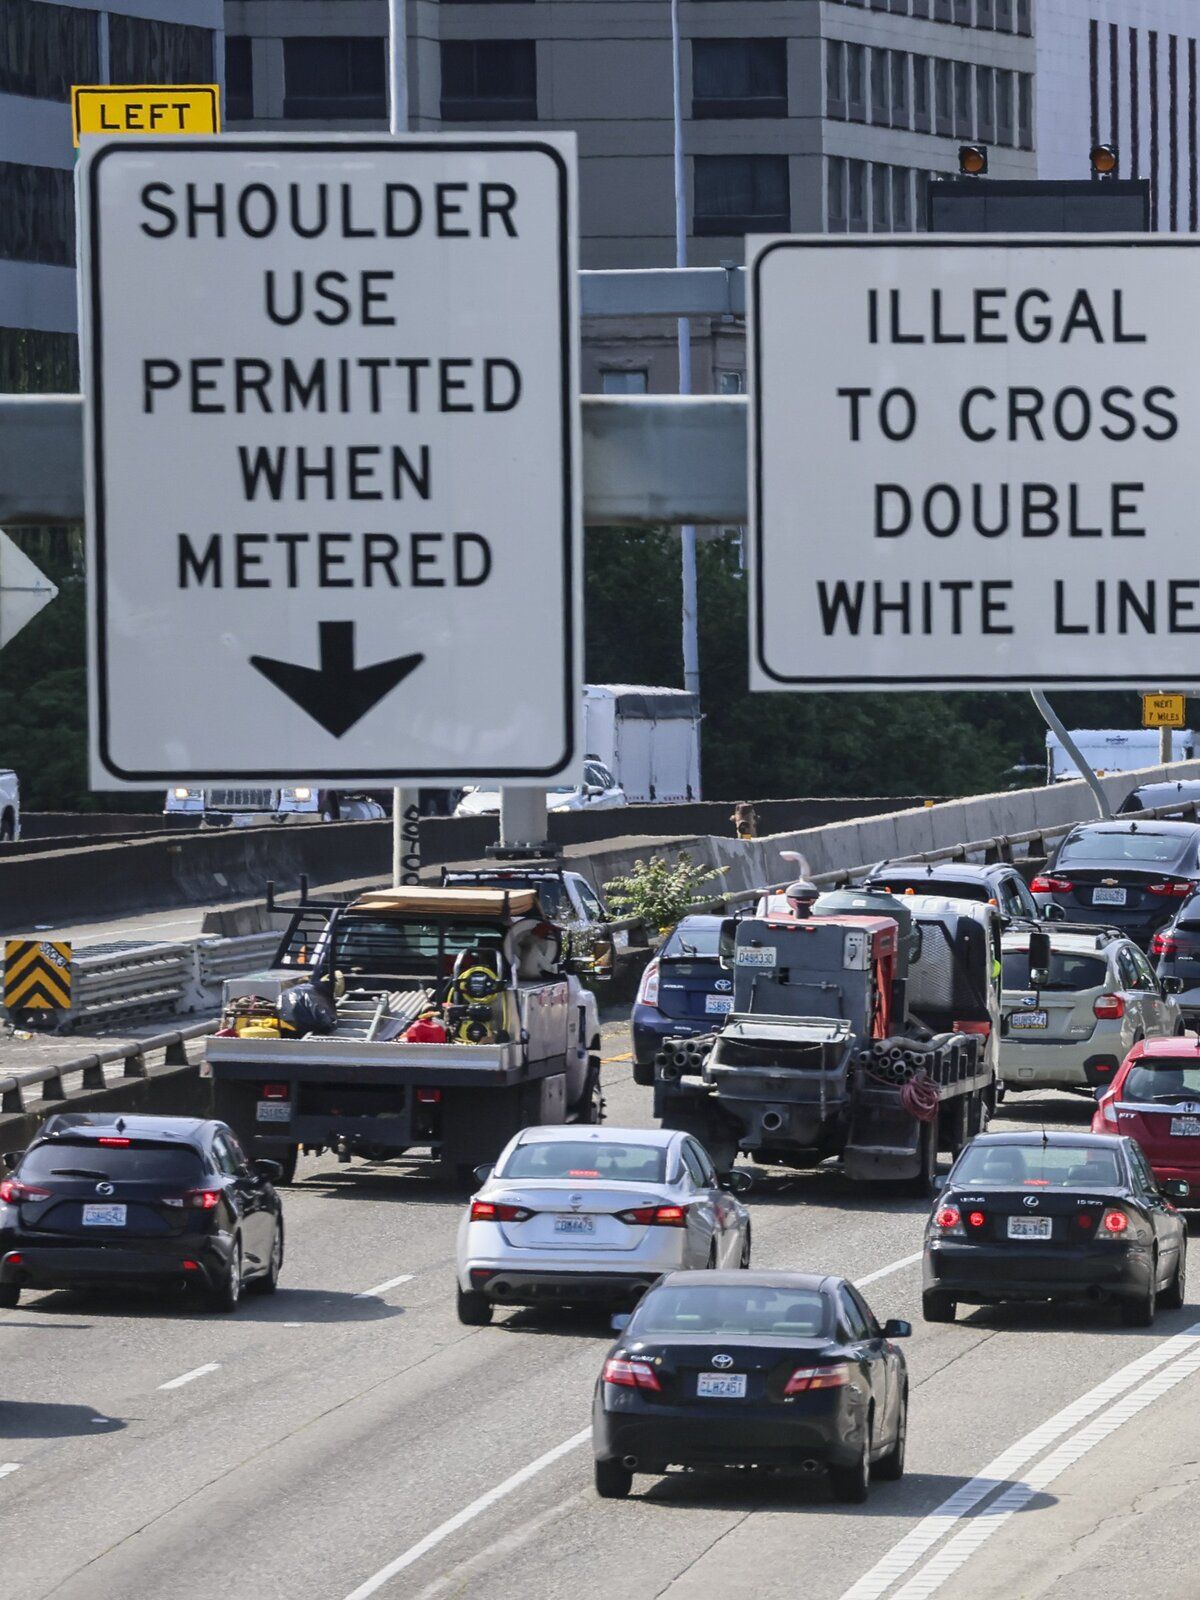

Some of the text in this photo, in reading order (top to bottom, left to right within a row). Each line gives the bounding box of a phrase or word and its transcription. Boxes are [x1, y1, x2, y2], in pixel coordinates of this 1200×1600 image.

[100, 103, 191, 130] LEFT
[139, 181, 520, 240] SHOULDER
[264, 269, 397, 327] USE
[868, 288, 1148, 345] ILLEGAL
[142, 357, 522, 415] PERMITTED
[837, 385, 1178, 443] TO CROSS
[237, 444, 432, 502] WHEN
[874, 482, 1146, 539] DOUBLE
[177, 531, 494, 590] METERED
[816, 579, 1015, 637] WHITE
[1153, 700, 1173, 709] NEXT
[1157, 712, 1180, 721] MILES
